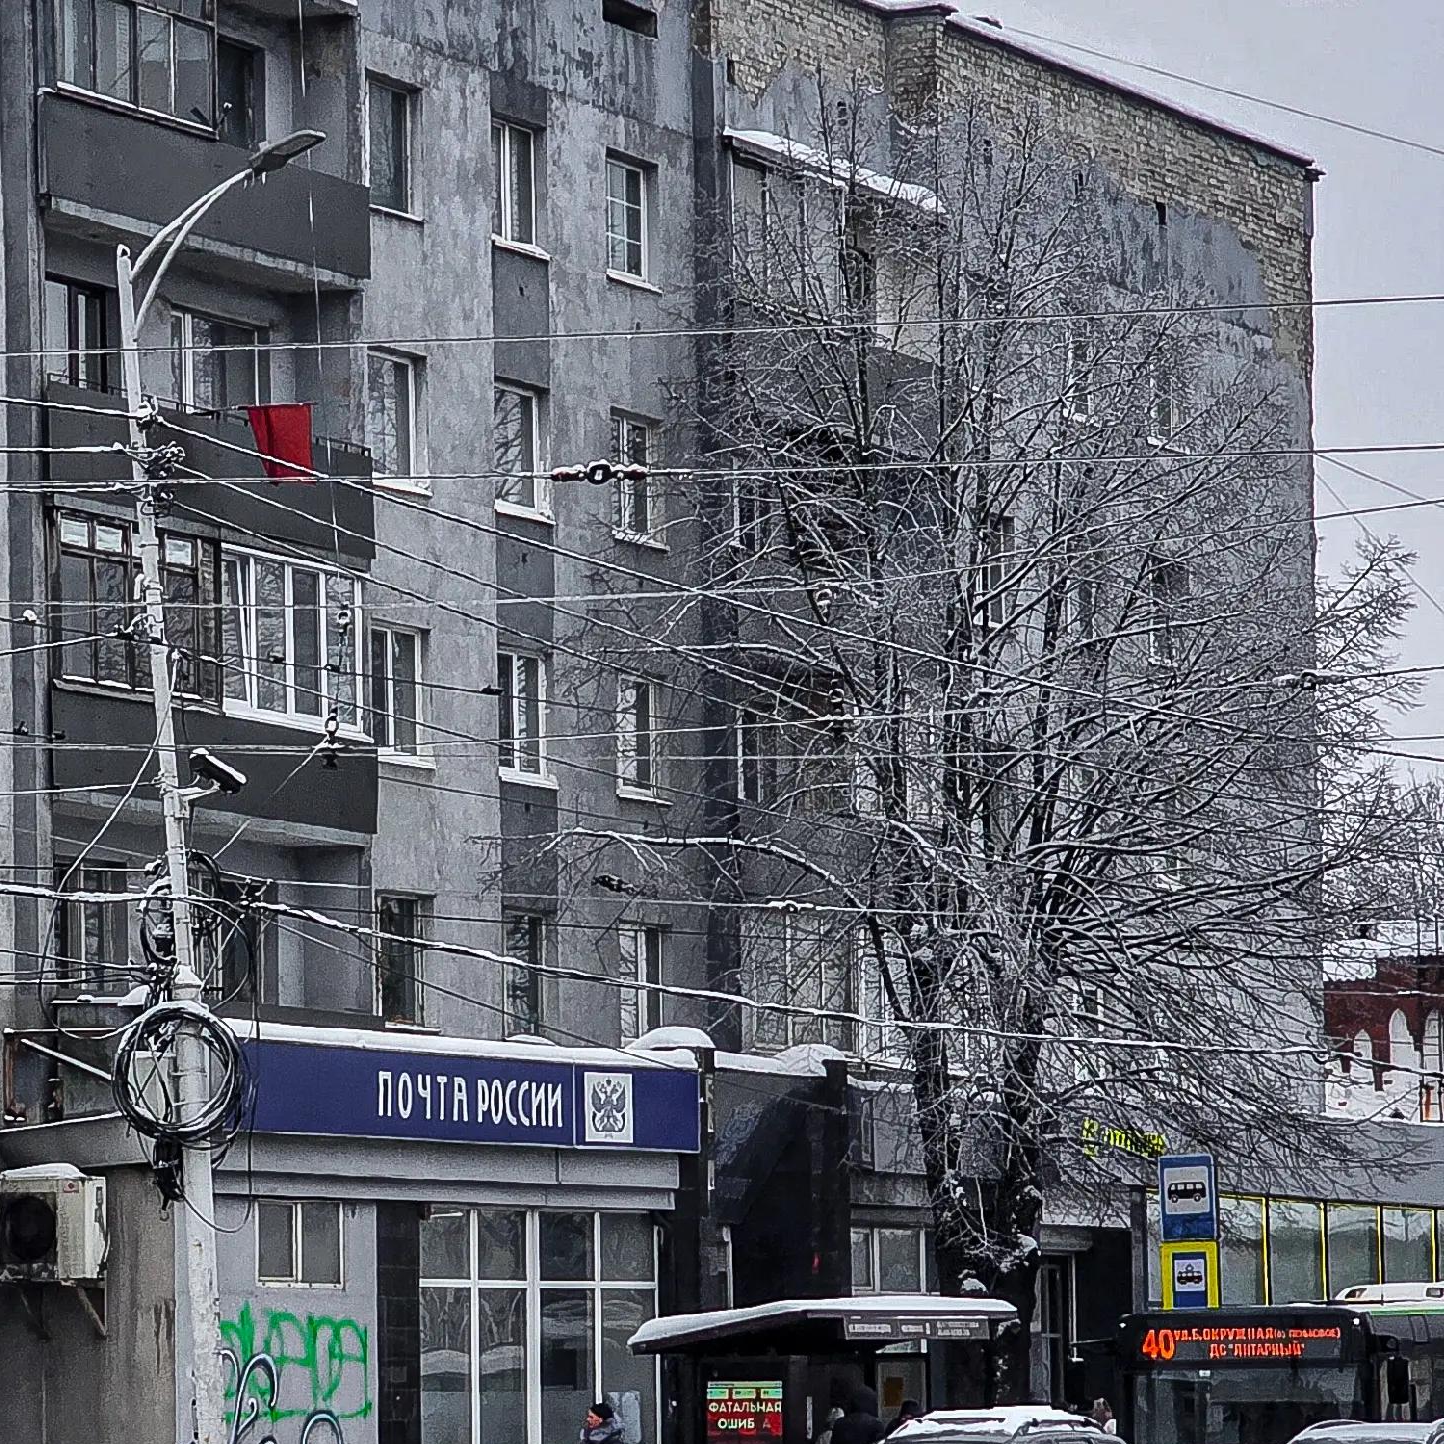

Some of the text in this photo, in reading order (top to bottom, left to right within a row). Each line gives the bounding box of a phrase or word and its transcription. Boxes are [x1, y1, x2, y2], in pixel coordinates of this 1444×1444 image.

[378, 1071, 563, 1128] ПОЧТА РОССИИ
[1142, 1329, 1175, 1359] 40
[708, 1400, 782, 1413] ФАТАЛЬНАЯ
